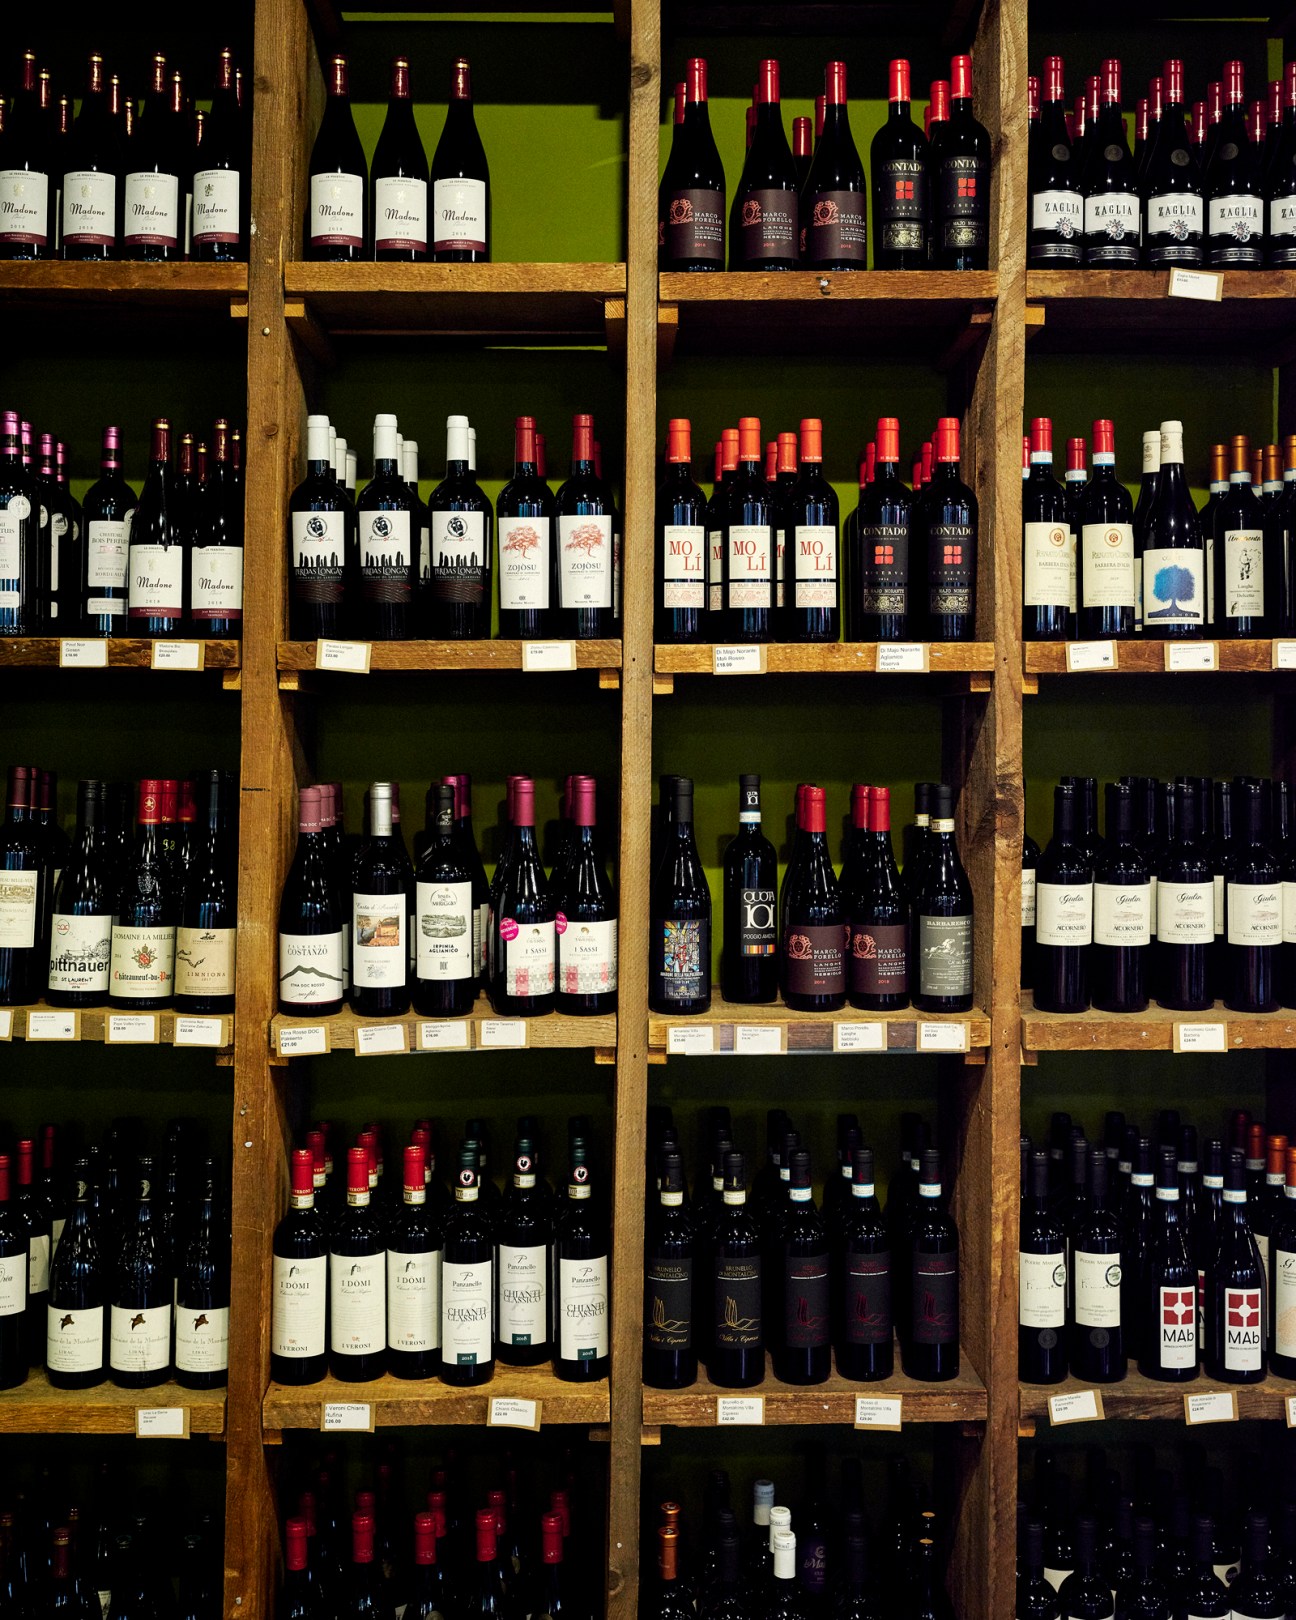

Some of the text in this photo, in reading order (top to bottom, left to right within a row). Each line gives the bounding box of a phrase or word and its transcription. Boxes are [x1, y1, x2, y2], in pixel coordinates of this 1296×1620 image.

[1, 201, 38, 215] Madone
[69, 203, 106, 216] Madone
[132, 204, 168, 217] Madone
[197, 203, 228, 214] Madone
[319, 204, 353, 217] Madone
[1044, 202, 1080, 214] ZAGLIA
[1095, 205, 1133, 217] ZAGLIA
[1158, 205, 1197, 217] ZAGLIA
[1220, 207, 1258, 219] ZAGLIA
[385, 208, 419, 222] Madone
[442, 209, 477, 222] Madone
[863, 527, 907, 536] CONTADO
[930, 527, 974, 536] CONTADO
[669, 541, 693, 556] MO
[733, 541, 756, 556] MO
[799, 541, 824, 556] MO
[507, 563, 537, 572] ZOJÒSU
[571, 562, 602, 571] ZOJÒSU
[683, 553, 702, 571] LÍ
[746, 553, 767, 571] LÍ
[814, 553, 833, 571] LÍ
[136, 576, 172, 589] Madone
[198, 577, 234, 590] Madone
[743, 891, 775, 904] QUOTA
[287, 948, 328, 956] COSTANZO
[50, 957, 109, 973] pittnauer
[507, 1263, 537, 1271] Panzanello
[402, 1276, 426, 1284] DOMI
[452, 1280, 482, 1288] Panzanello
[571, 1276, 601, 1284] Panzanello
[503, 1289, 541, 1299] CHIANTI
[503, 1296, 541, 1304] CLASSICO
[448, 1306, 486, 1316] CHIANTI
[566, 1301, 605, 1312] CHIANTI
[447, 1313, 487, 1322] CLASSICO
[566, 1309, 605, 1318] CLASSICO
[1163, 1328, 1195, 1342] MAb
[1228, 1330, 1260, 1344] MAb
